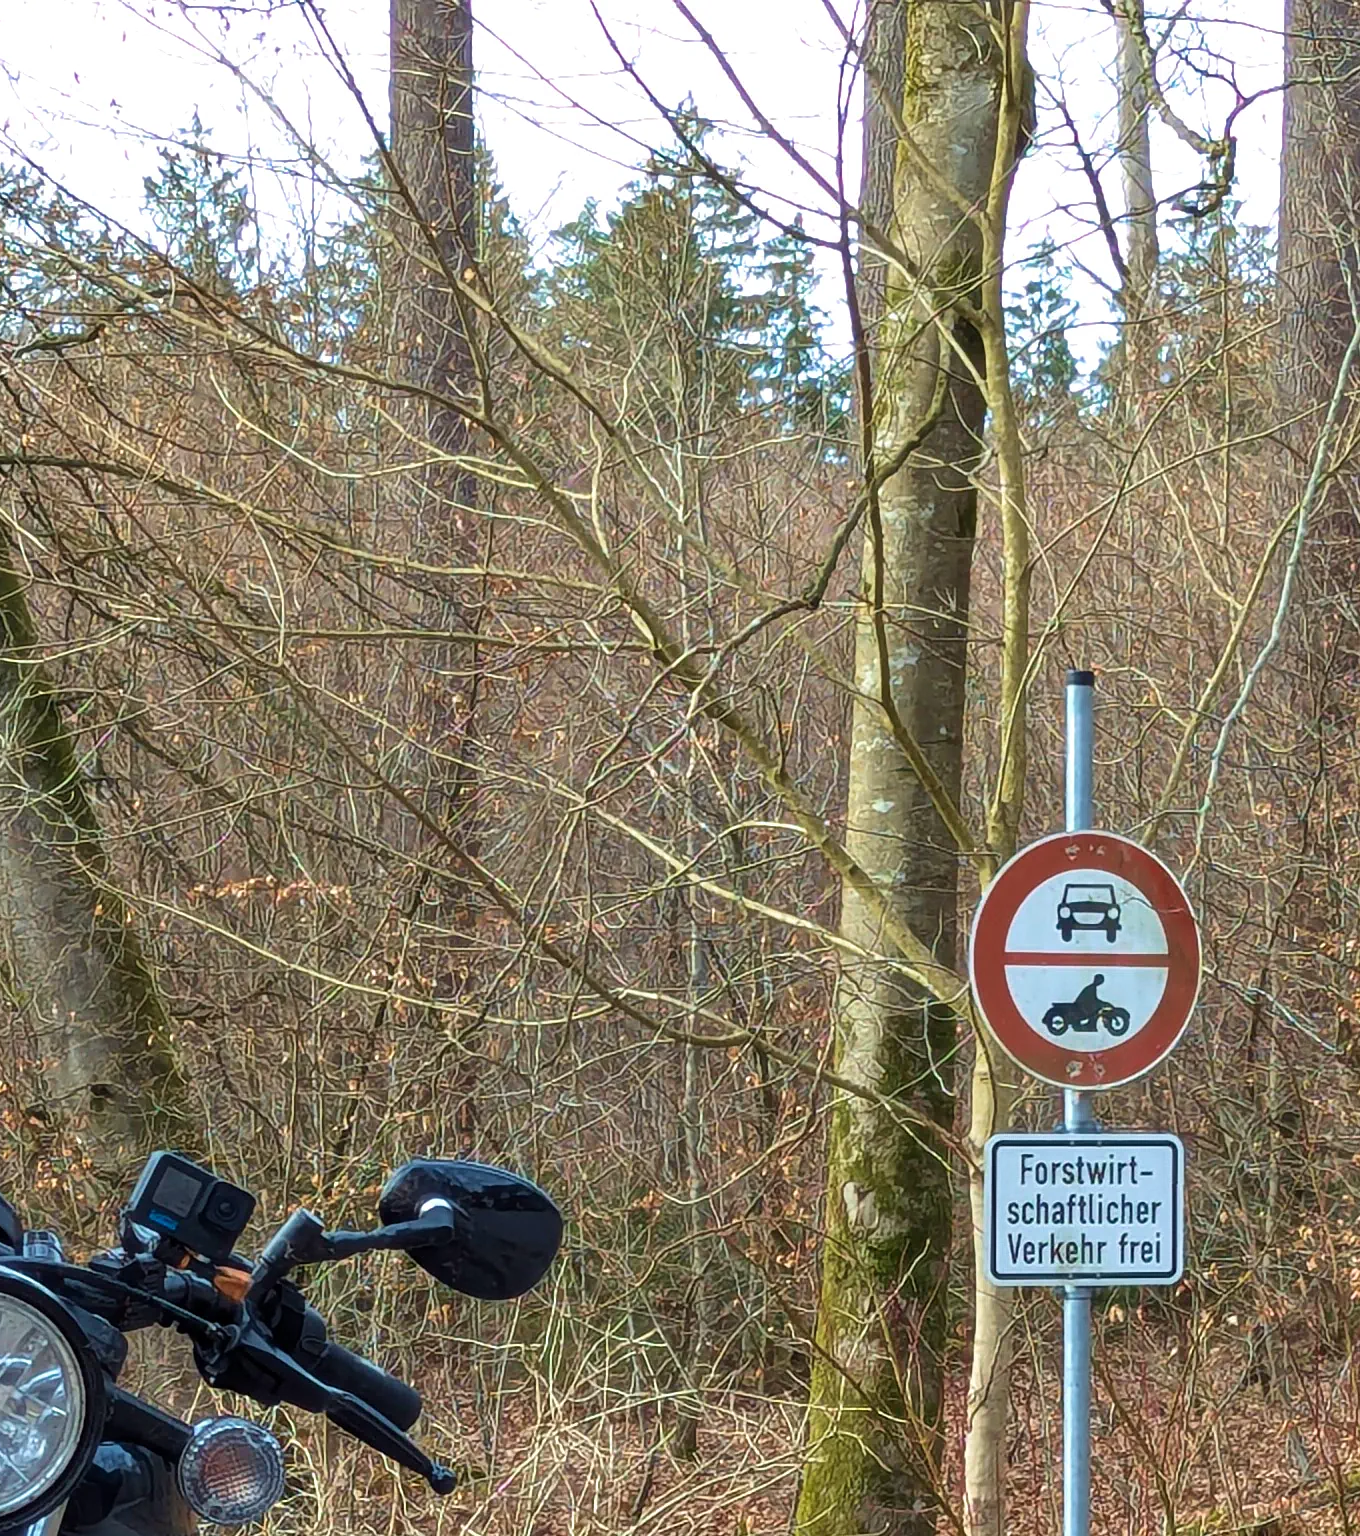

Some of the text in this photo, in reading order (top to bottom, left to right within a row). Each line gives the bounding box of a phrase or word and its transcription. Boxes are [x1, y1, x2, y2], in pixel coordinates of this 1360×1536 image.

[1020, 1153, 1153, 1185] Forstwirt-
[1007, 1193, 1162, 1225] schaftlicher
[1007, 1232, 1161, 1264] Verkehr frei
